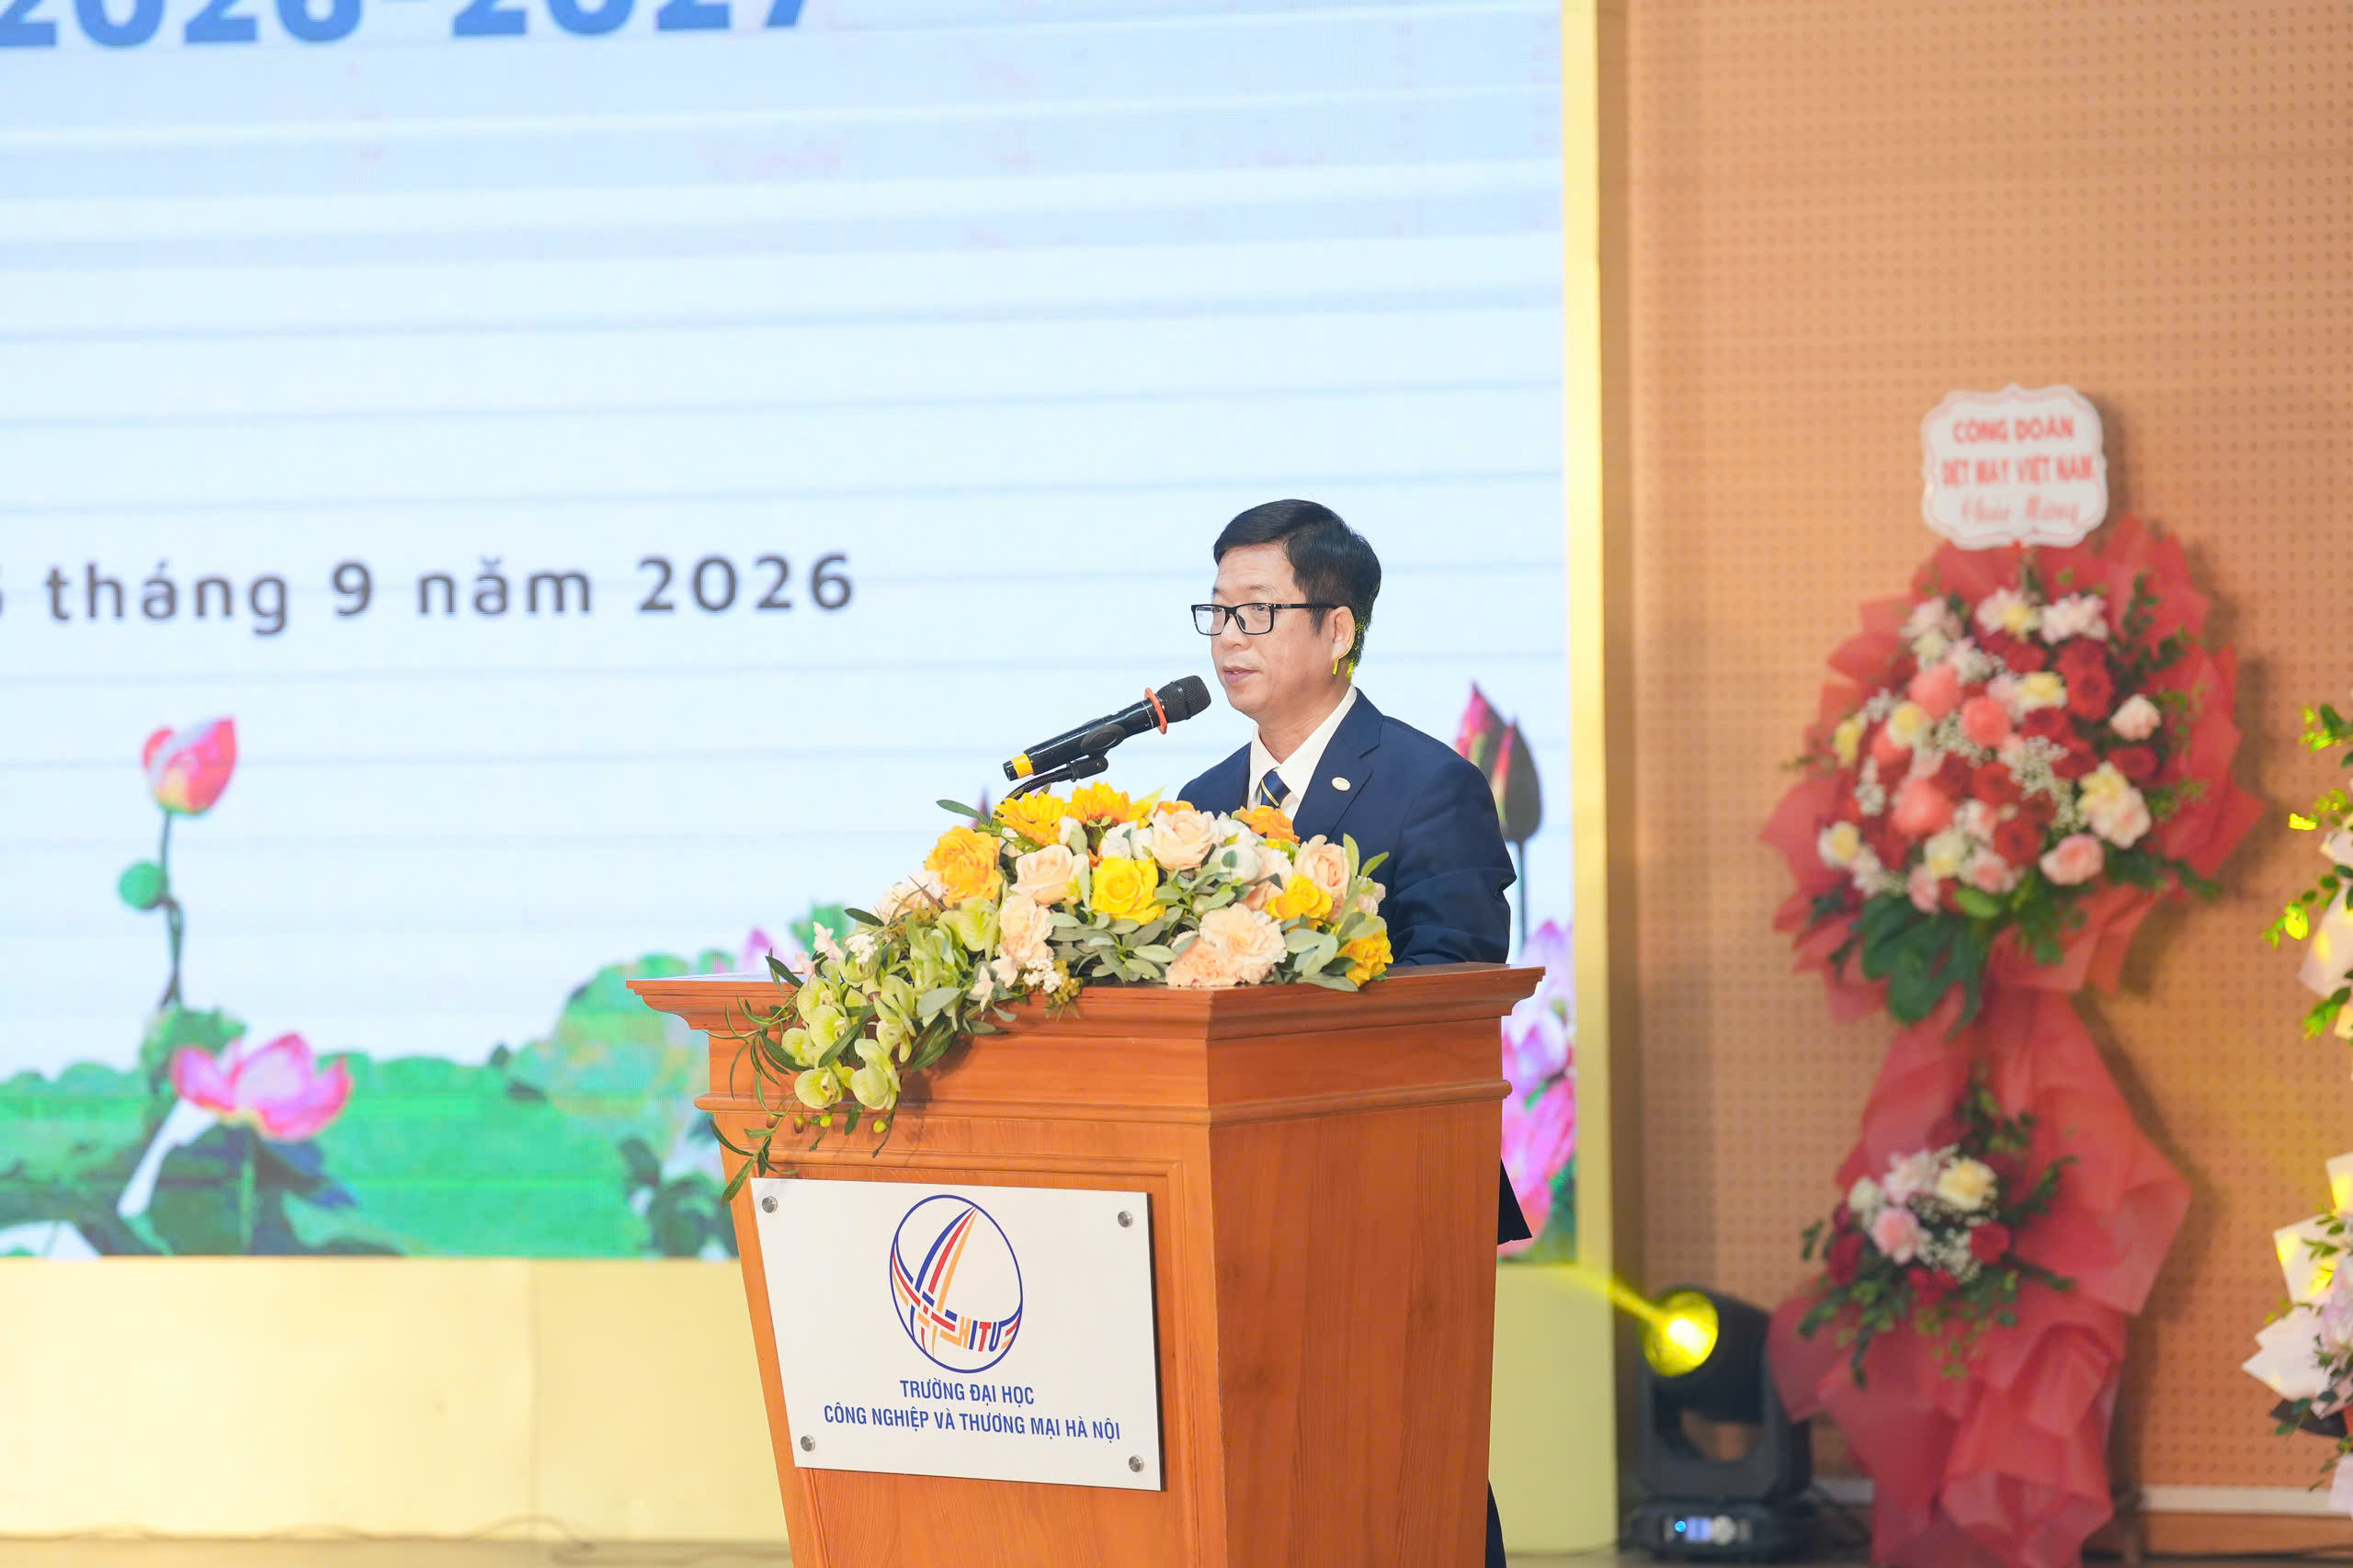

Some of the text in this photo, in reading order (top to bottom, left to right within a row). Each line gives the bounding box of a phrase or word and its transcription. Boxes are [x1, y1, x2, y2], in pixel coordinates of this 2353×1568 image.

[45, 558, 288, 635] tháng
[332, 562, 372, 617] 9
[418, 556, 591, 616] năm
[638, 553, 853, 612] 2026
[899, 1377, 1035, 1408] TRƯỜNG ĐẠI HỌC
[824, 1402, 1120, 1444] CÔNG NGHIỆP VÀ THƯƠNG MẠI HÀ NỘI
